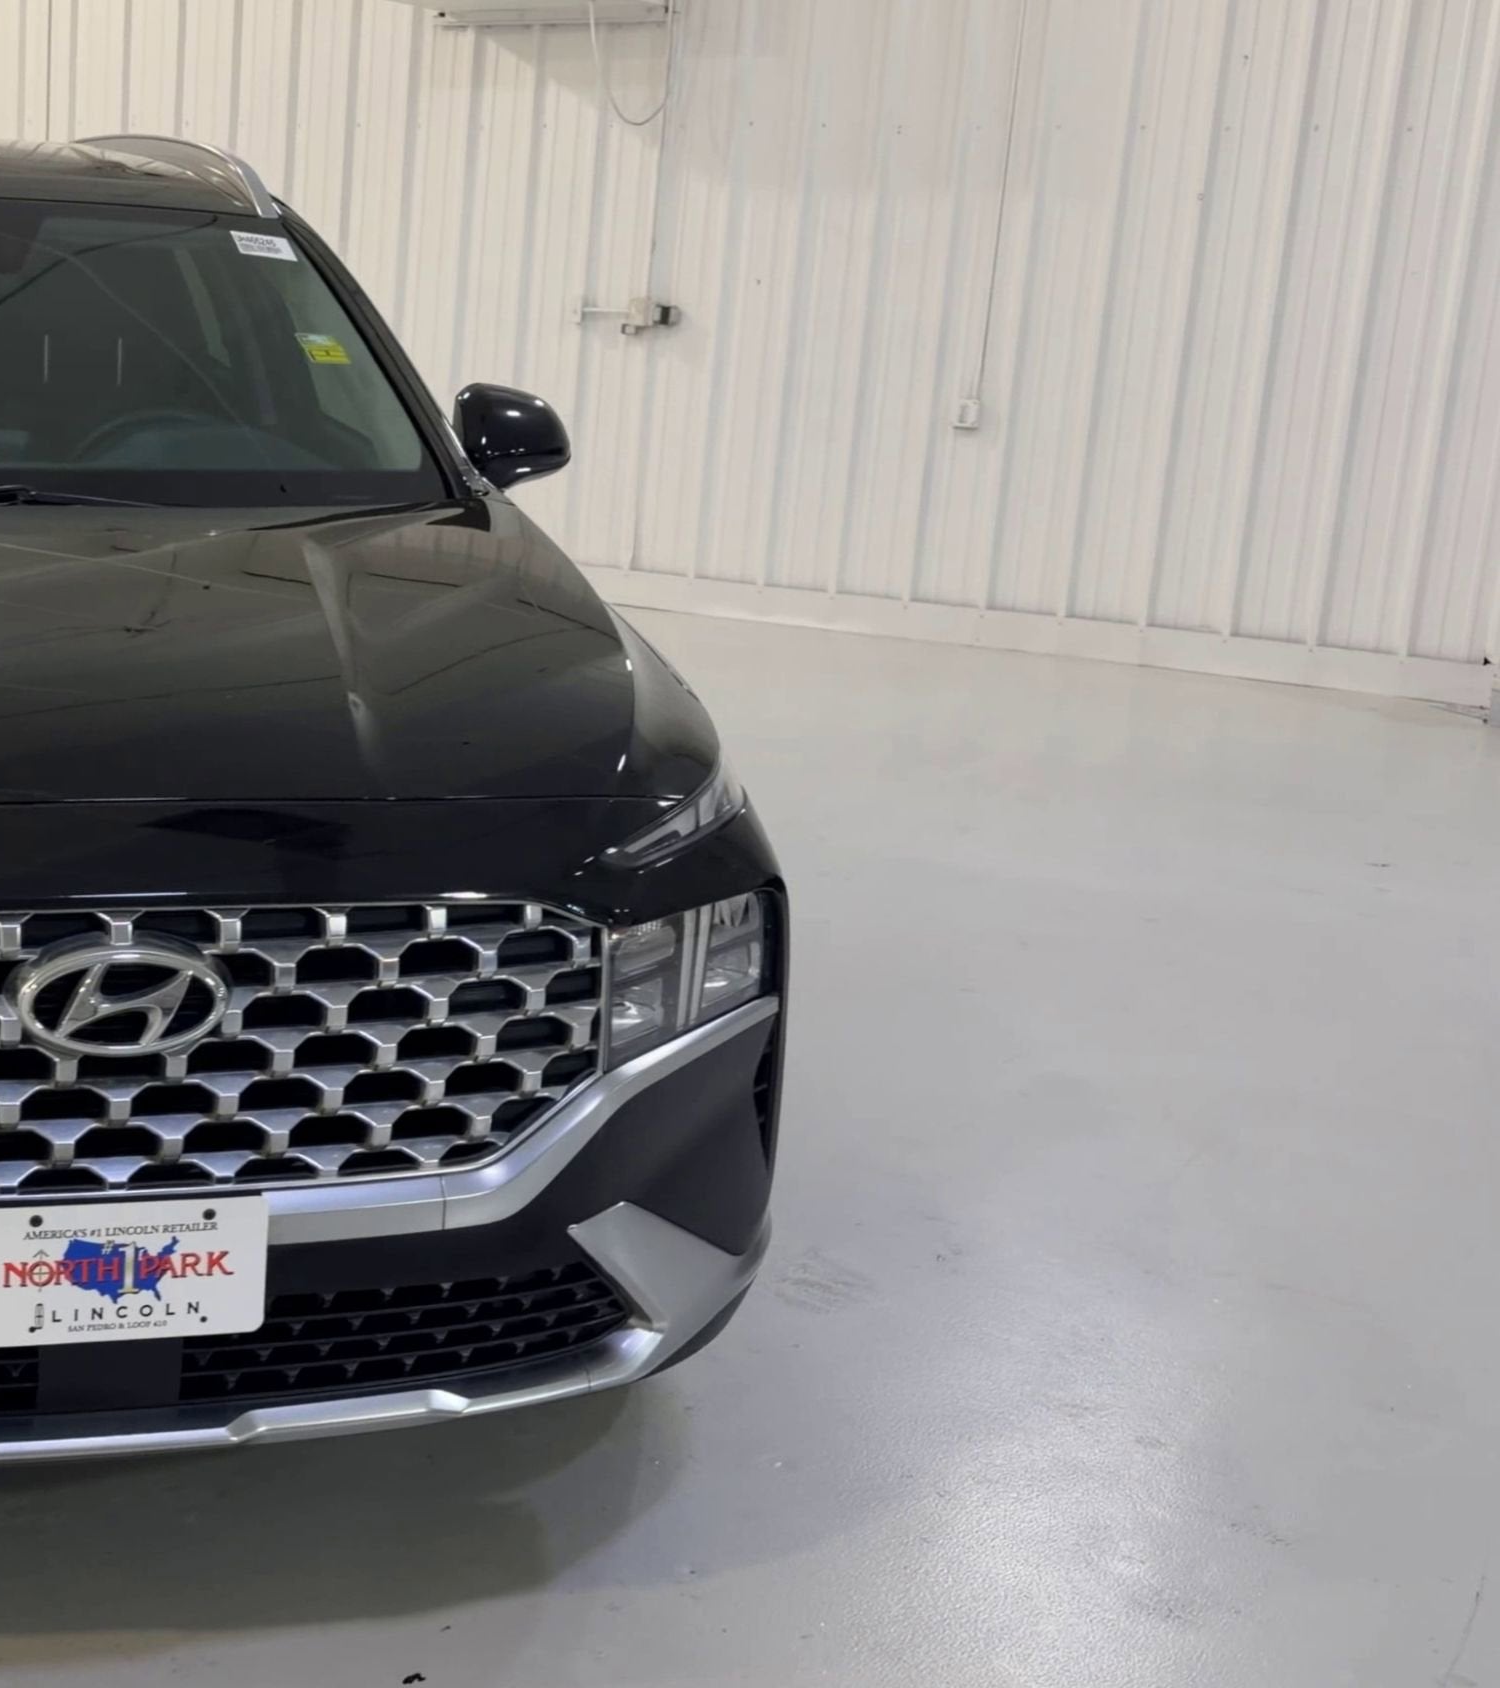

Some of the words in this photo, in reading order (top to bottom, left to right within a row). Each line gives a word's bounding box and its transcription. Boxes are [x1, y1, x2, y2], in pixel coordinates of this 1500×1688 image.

[23, 1228, 87, 1240] AMERICA'S
[89, 1227, 102, 1237] #1
[105, 1224, 160, 1237] LINCOLN
[162, 1221, 218, 1233] RETAILER
[2, 1254, 121, 1288] NORTH
[139, 1251, 234, 1279] PARK
[51, 1301, 200, 1323] LINCOLN
[68, 1324, 85, 1332] SAN
[87, 1323, 116, 1331] PEDRO
